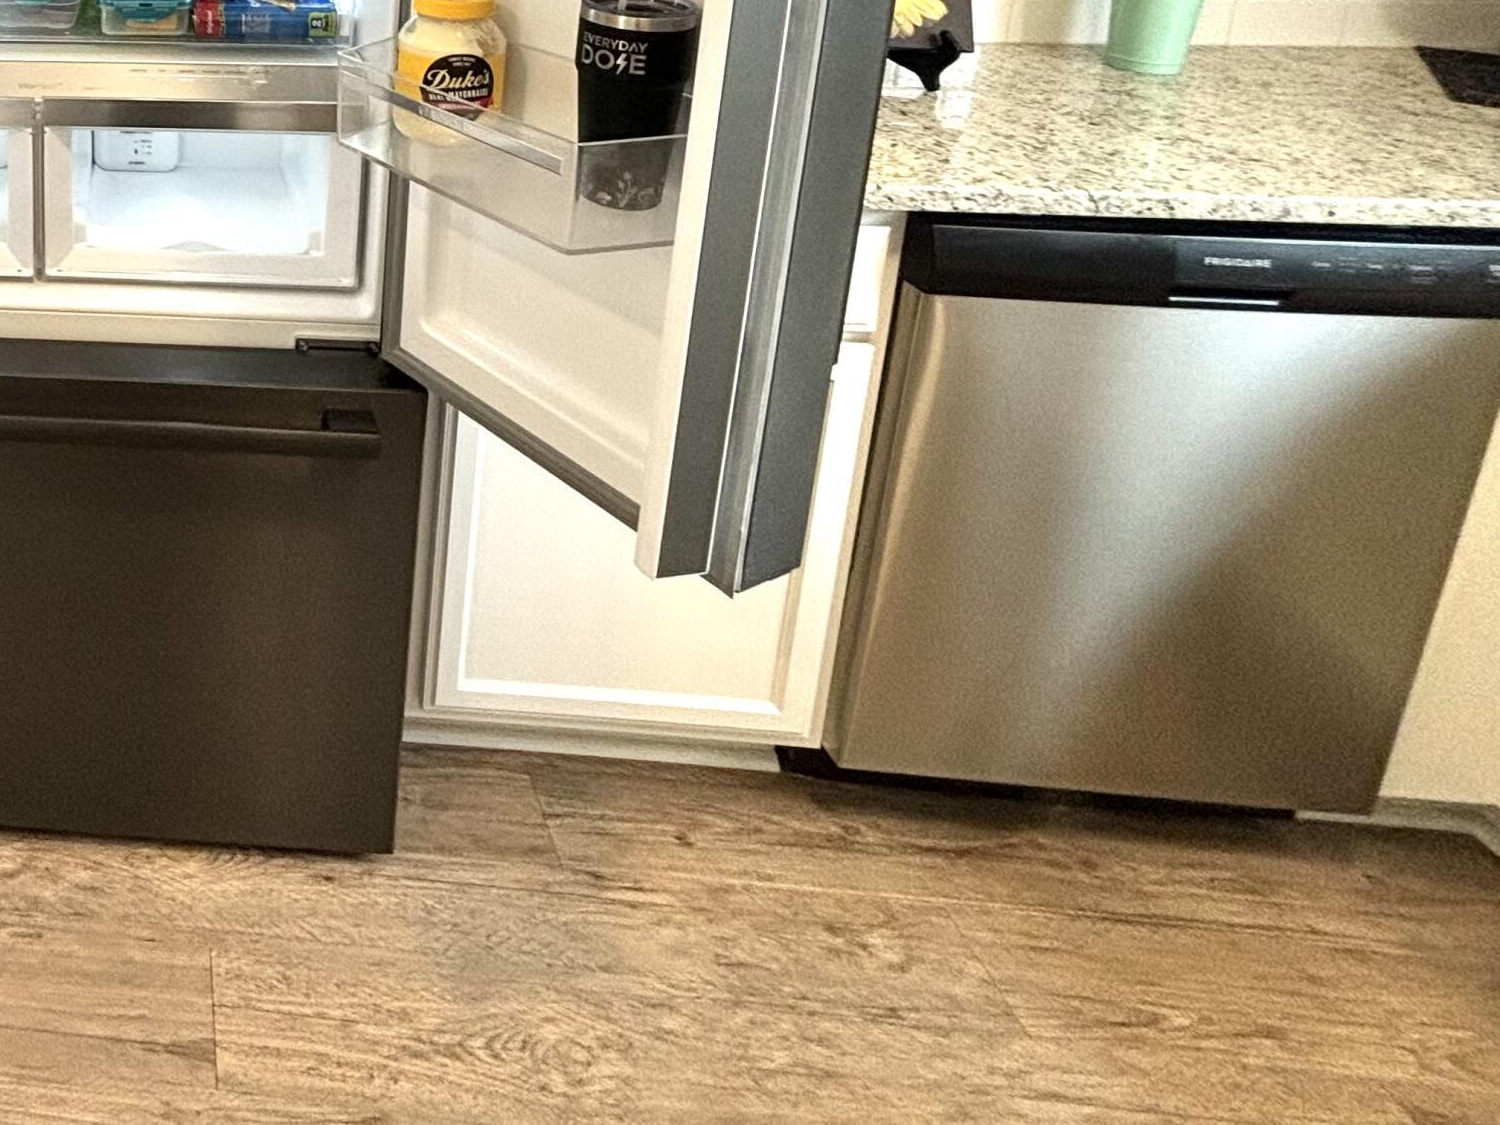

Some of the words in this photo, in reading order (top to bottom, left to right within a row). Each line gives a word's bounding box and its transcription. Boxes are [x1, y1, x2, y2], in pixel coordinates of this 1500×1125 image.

[583, 30, 649, 54] EVERYDAY
[426, 68, 490, 90] Duke's
[1203, 256, 1273, 269] FRIGIDAIRE
